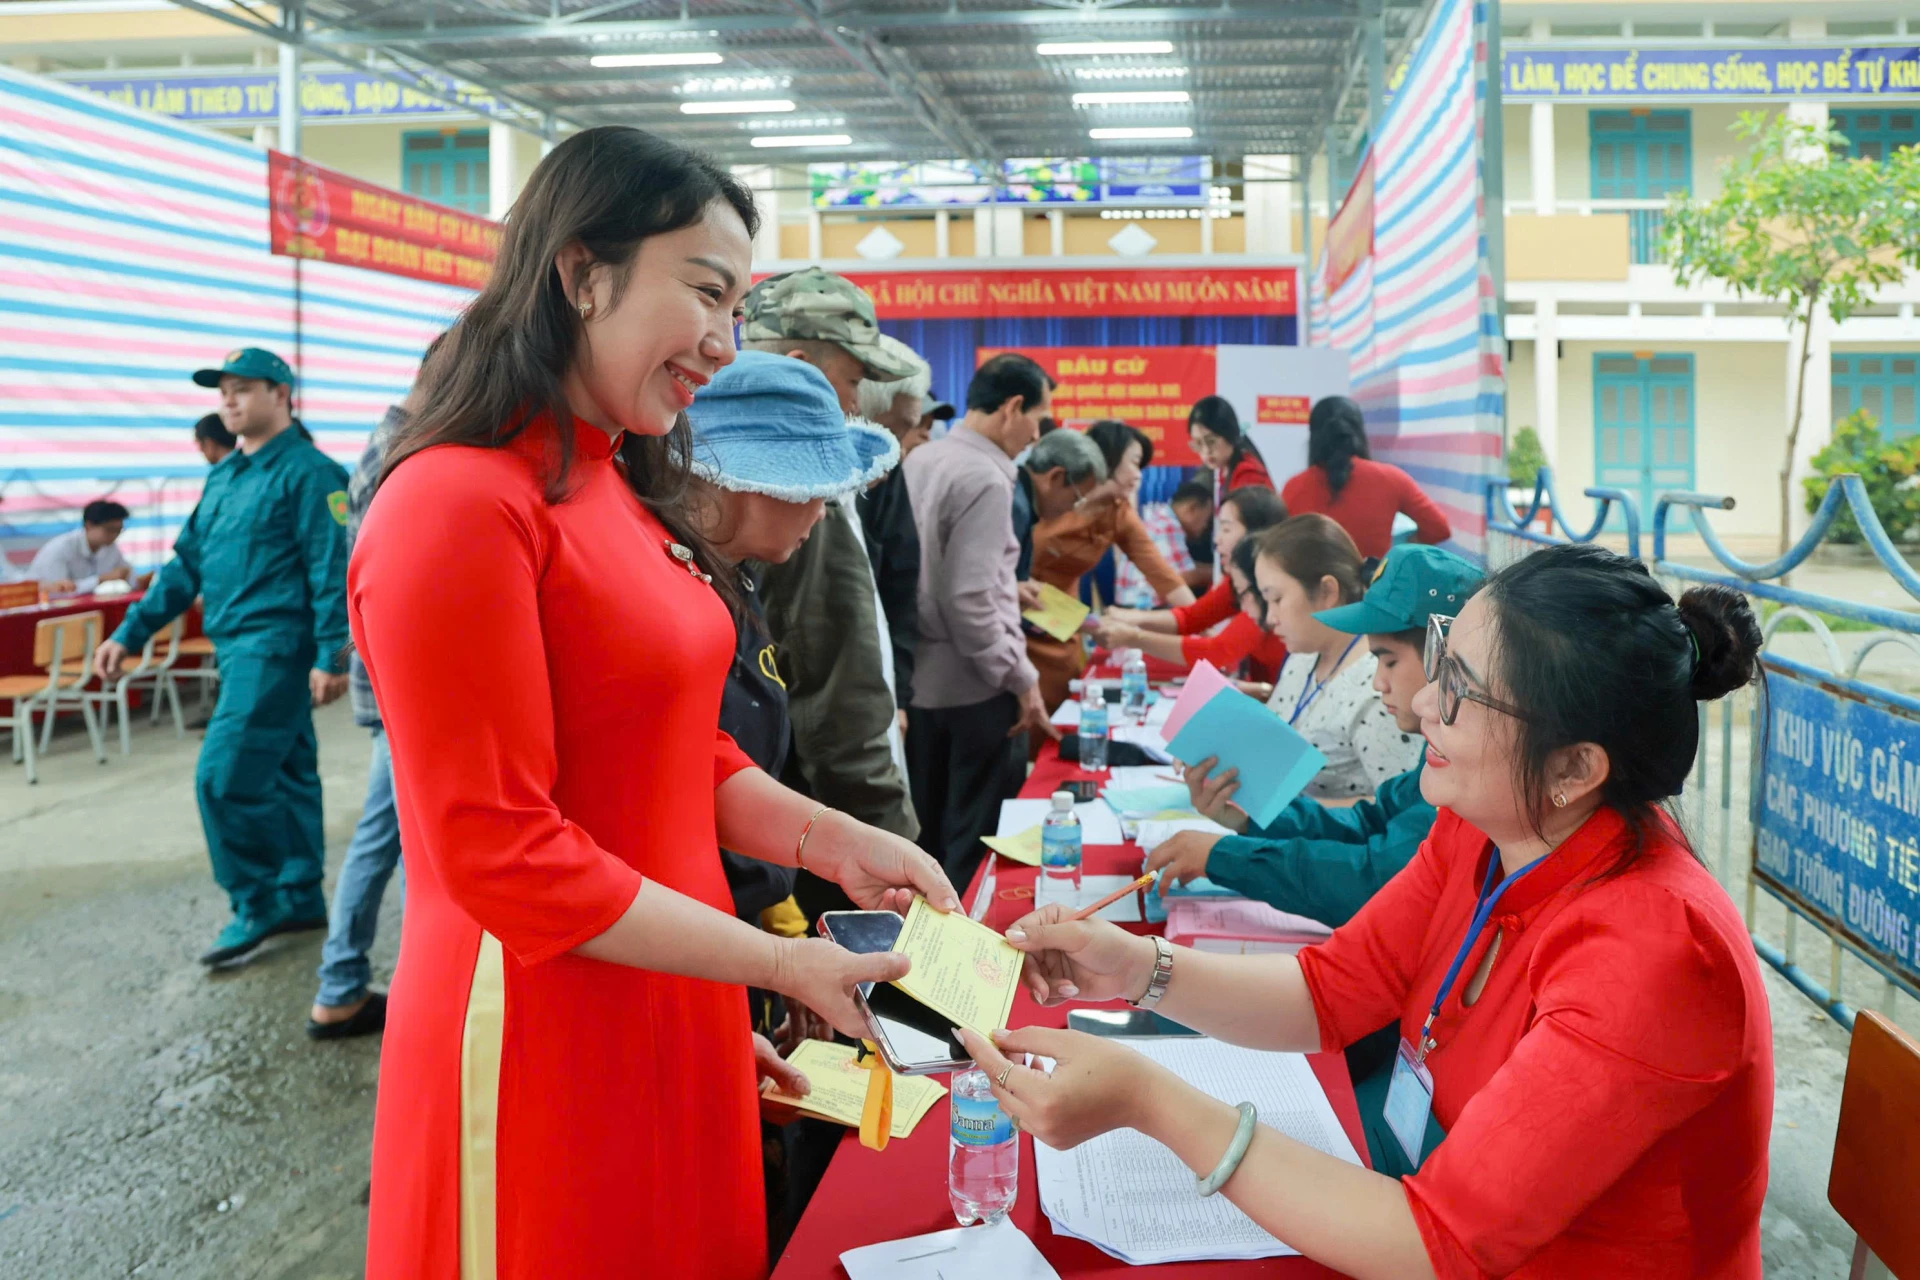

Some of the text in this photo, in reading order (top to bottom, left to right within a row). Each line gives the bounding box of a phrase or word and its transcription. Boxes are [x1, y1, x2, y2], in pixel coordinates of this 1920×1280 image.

[189, 86, 243, 114] THEO
[1510, 56, 1561, 95] LÀM,
[1564, 62, 1606, 96] HỌC
[1610, 49, 1639, 90] ĐỂ
[1642, 62, 1710, 90] CHUNG
[1712, 53, 1773, 94] SỐNG,
[1777, 61, 1819, 94] HỌC
[1823, 48, 1852, 89] ĐỂ
[1855, 56, 1885, 93] TỰ
[896, 278, 935, 310] HỘI
[938, 277, 981, 306] CHỦ
[987, 278, 1055, 305] NGHĨA
[1059, 276, 1109, 309] VIỆT
[1113, 280, 1162, 303] NAM
[1166, 274, 1230, 303] MUÔN
[1775, 709, 1814, 768] KHU
[1821, 723, 1864, 793] VỰC
[1766, 771, 1920, 900] CÁC PHƯƠNG TIỆ
[1794, 847, 1844, 918] THÔNG
